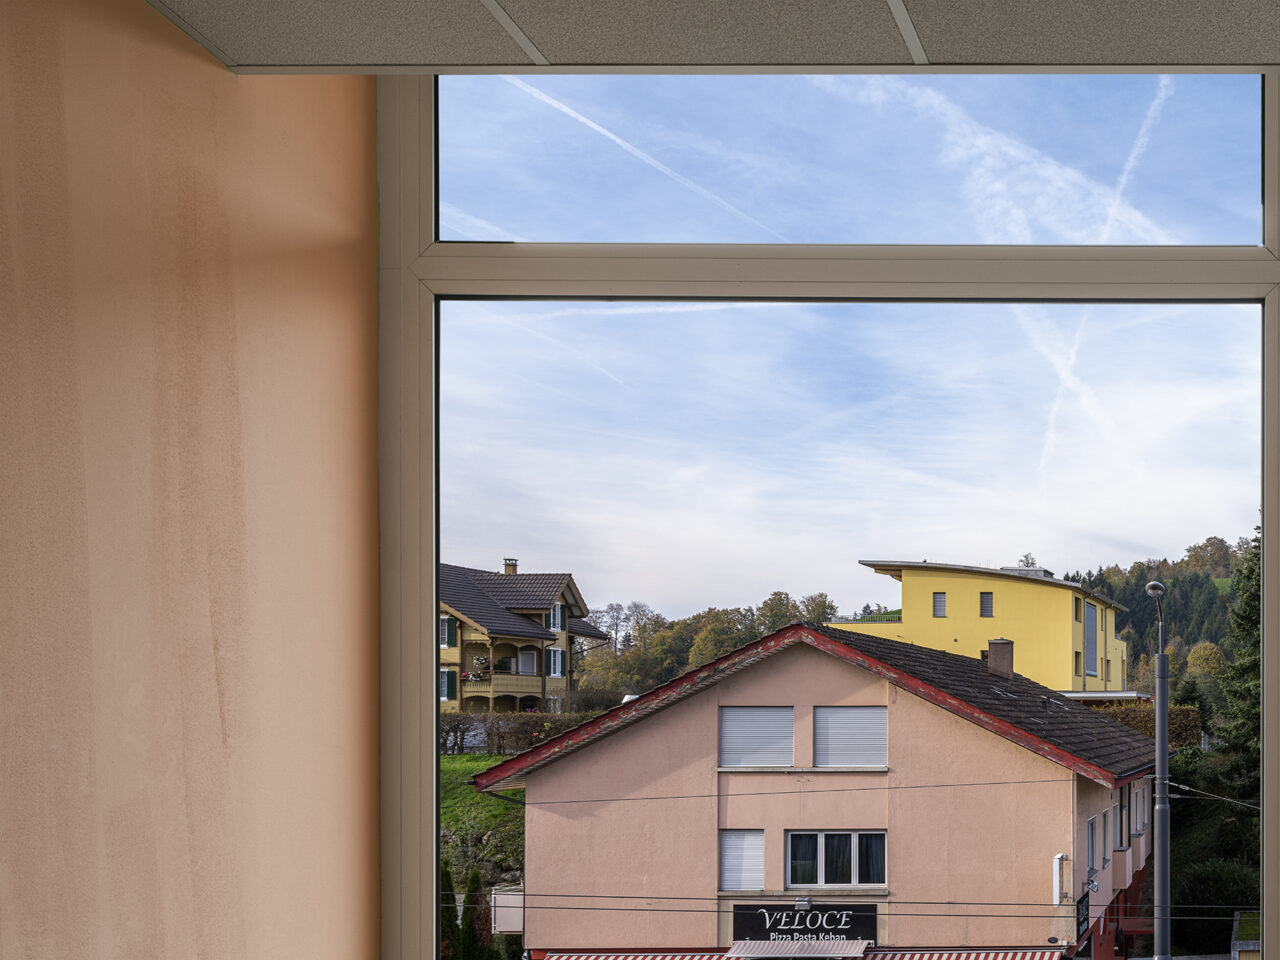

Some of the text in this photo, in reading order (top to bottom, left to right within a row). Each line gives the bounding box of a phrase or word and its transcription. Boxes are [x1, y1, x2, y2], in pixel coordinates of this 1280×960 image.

[757, 908, 853, 929] VELOCE
[770, 932, 792, 941] Pizza
[793, 932, 817, 941] Pasta
